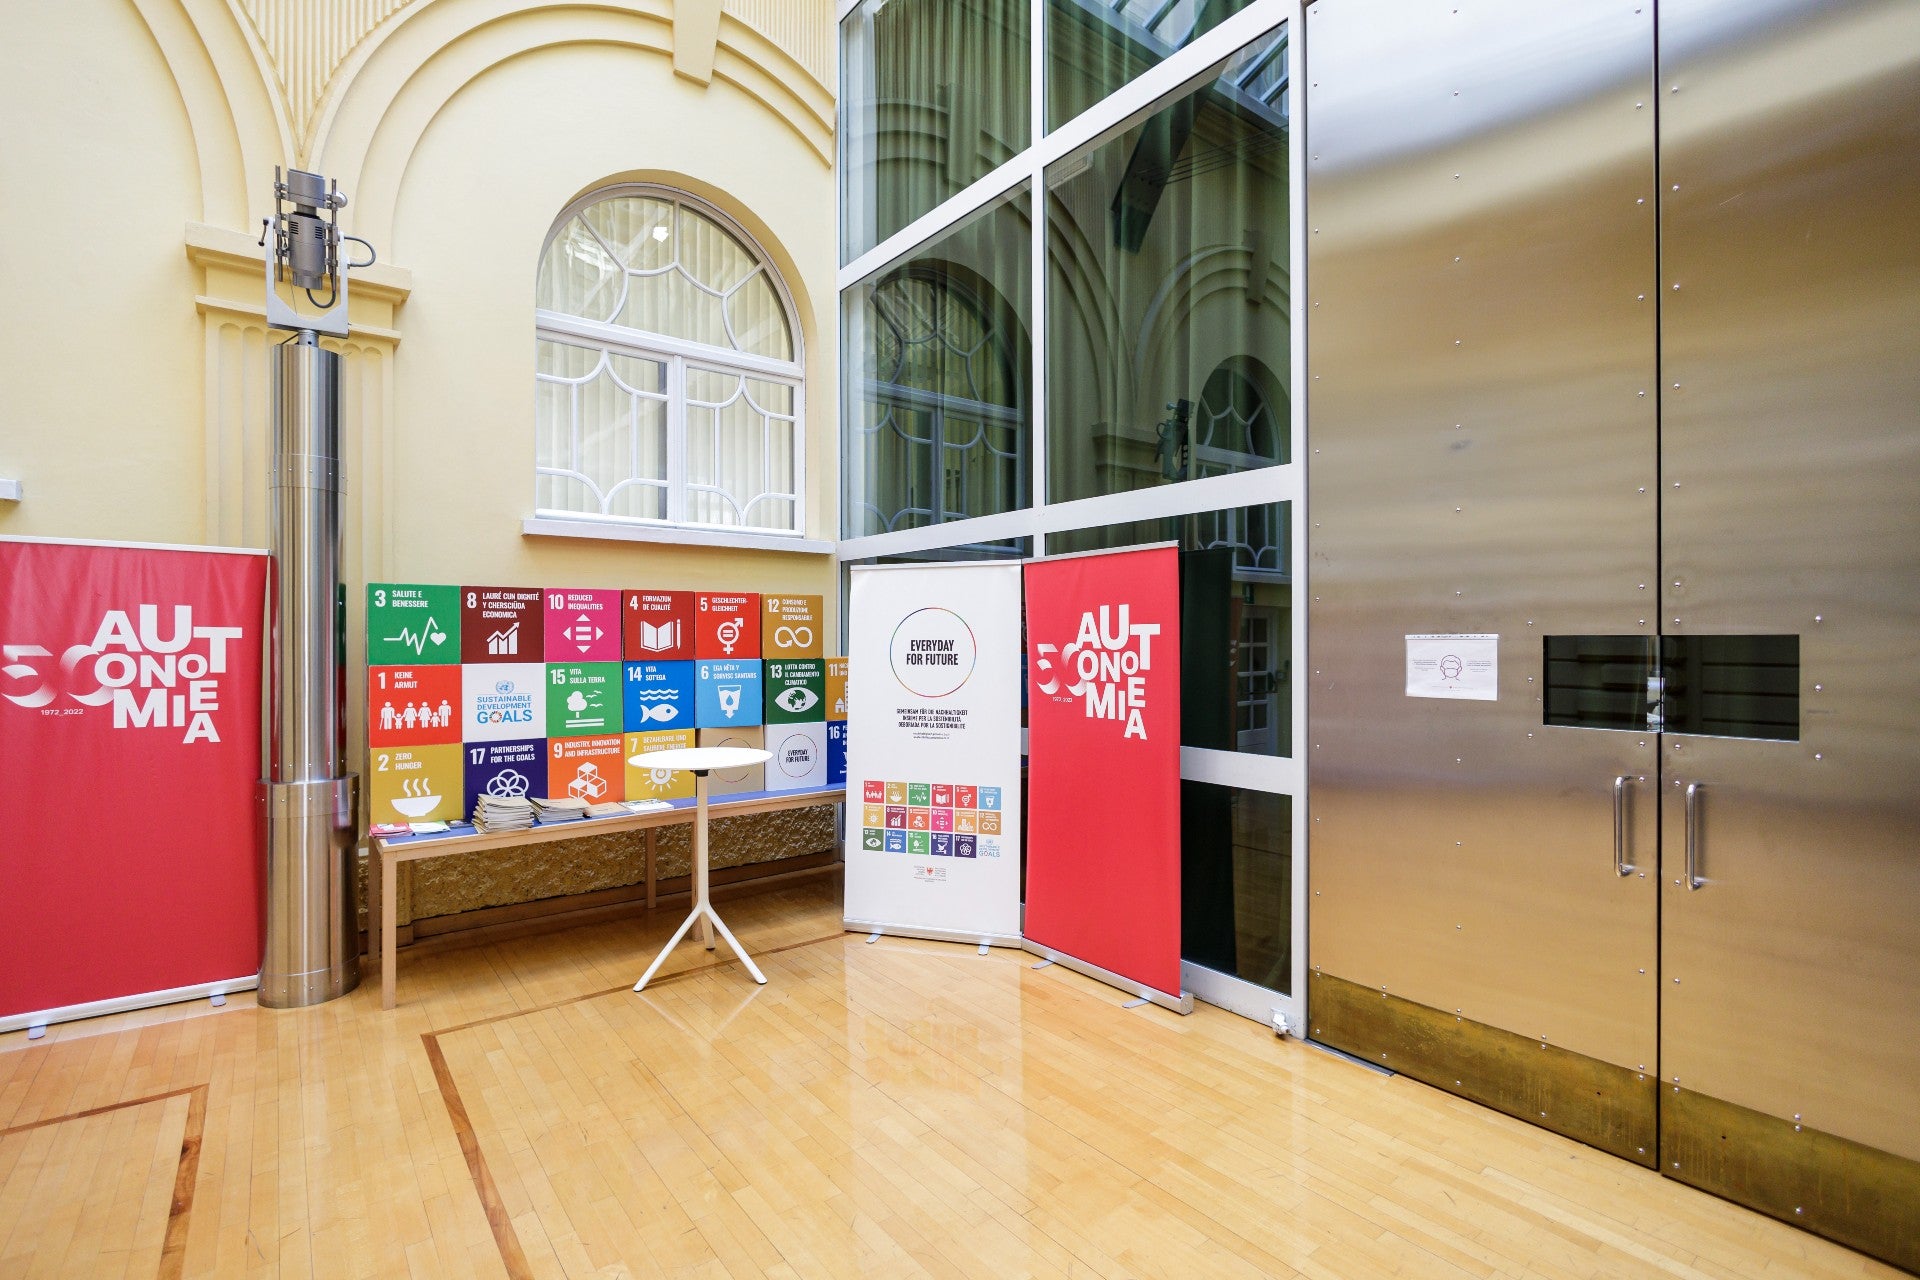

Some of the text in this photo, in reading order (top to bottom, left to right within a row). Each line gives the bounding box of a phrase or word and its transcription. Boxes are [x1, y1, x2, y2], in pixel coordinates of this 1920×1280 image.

[375, 590, 386, 607] 3
[467, 592, 477, 608] 8
[517, 592, 540, 600] DIGNITÉ
[548, 594, 564, 610] 10
[630, 596, 638, 610] 4
[700, 597, 708, 611] 5
[768, 599, 779, 612] 12
[911, 640, 954, 651] EVERYDAY
[907, 654, 958, 665] FOR FUTURE
[550, 669, 566, 684] 15
[628, 666, 642, 682] 14
[701, 666, 709, 679] 6
[770, 664, 782, 678] 13
[829, 663, 838, 676] 11
[378, 672, 386, 689] 1
[477, 710, 532, 724] GOALS
[829, 726, 840, 739] 16
[490, 745, 534, 754] PARTNERSHIPS
[592, 739, 620, 747] INNOVATION
[631, 738, 638, 752] 7
[395, 752, 412, 760] ZERO
[470, 748, 486, 765] 17
[554, 742, 563, 759] 9
[577, 748, 620, 756] INFRASTRUCTURE
[378, 754, 389, 772] 2
[504, 754, 515, 762] THE
[395, 761, 422, 770] HUNGER
